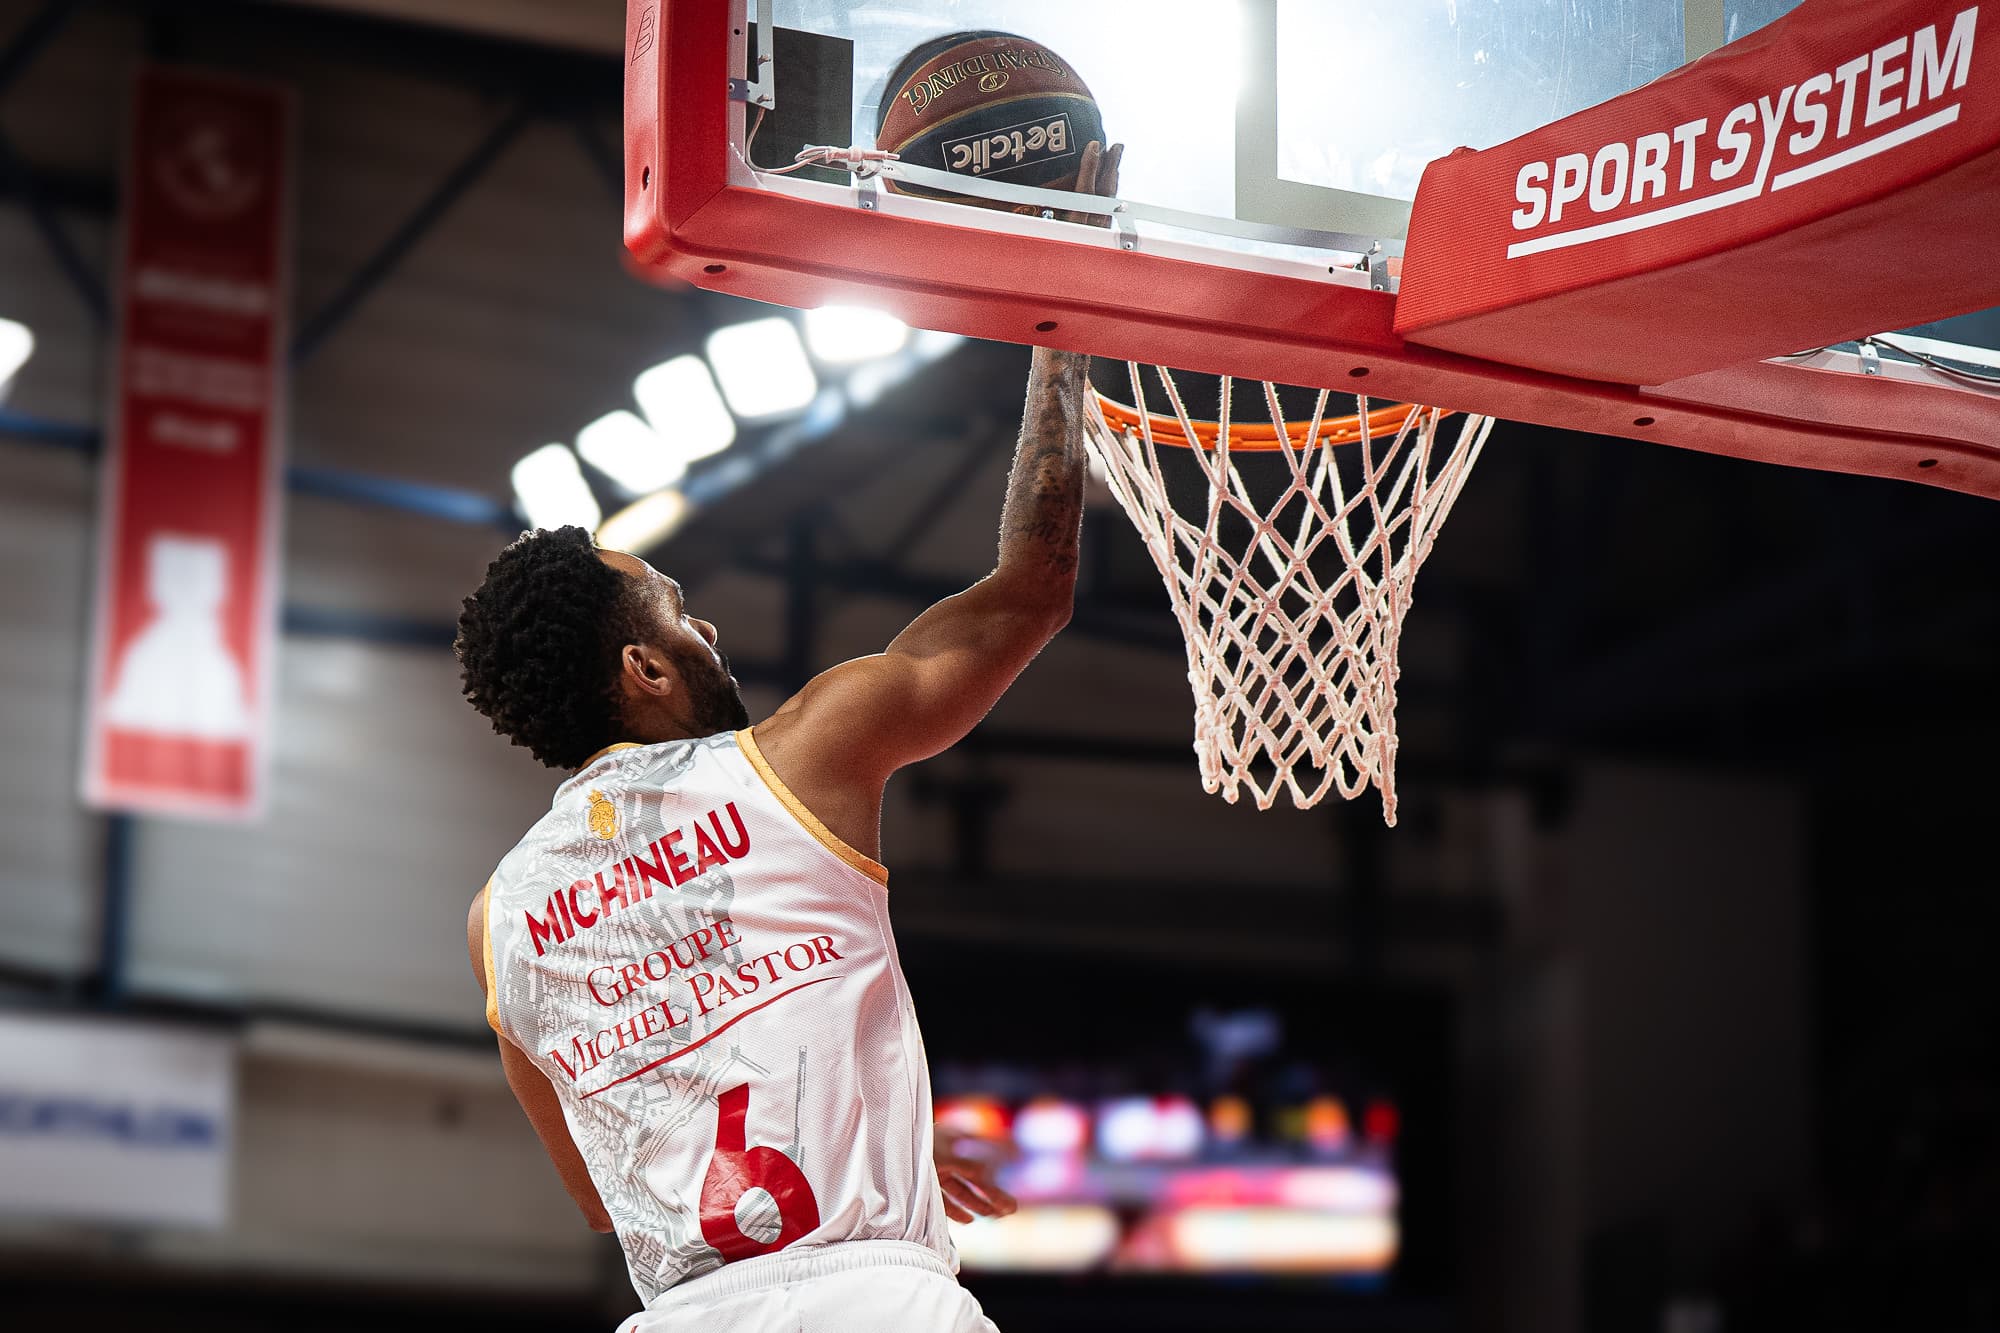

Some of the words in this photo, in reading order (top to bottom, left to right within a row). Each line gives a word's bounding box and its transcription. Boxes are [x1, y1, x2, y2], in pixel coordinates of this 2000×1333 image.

[902, 46, 1068, 116] SPALDING
[951, 119, 1067, 174] Betclic
[1511, 117, 1708, 231] SPORT
[1709, 5, 1979, 196] SYSTEM
[524, 801, 751, 957] MICHINEAU
[548, 998, 689, 1082] MICHEL
[685, 934, 845, 1017] PASTOR
[586, 916, 743, 1007] GROUPE
[699, 1082, 821, 1264] 6
